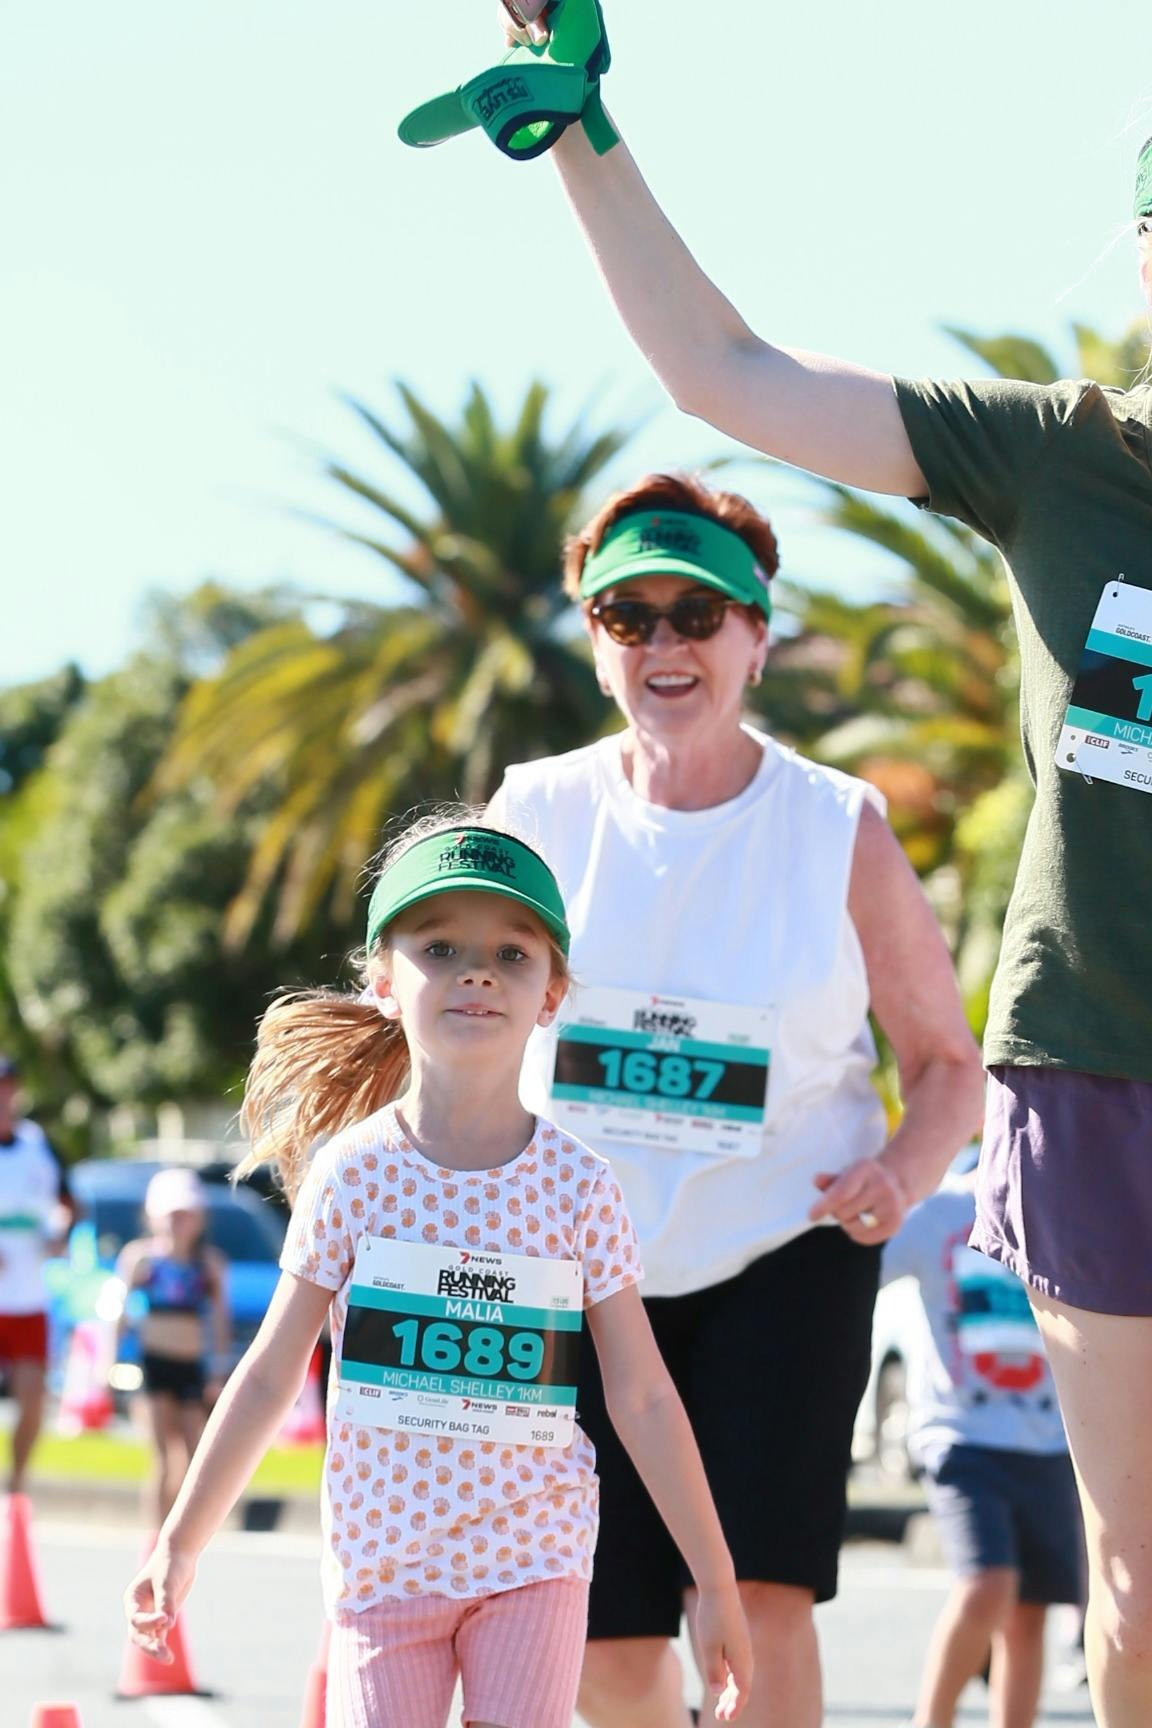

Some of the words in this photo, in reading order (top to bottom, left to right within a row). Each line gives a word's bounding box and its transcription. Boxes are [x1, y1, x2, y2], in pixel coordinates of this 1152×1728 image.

[598, 1049, 726, 1100] 1687
[438, 1269, 516, 1291] RUNNING
[448, 1265, 474, 1273] GOLD
[479, 1268, 509, 1276] COAST
[437, 1283, 514, 1303] FESTIVAL
[445, 1300, 504, 1323] MALIA
[391, 1319, 545, 1380] 1689
[382, 1370, 446, 1392] MICHAEL
[449, 1379, 515, 1400] SHELLEY
[516, 1389, 543, 1401] 1KM
[398, 1415, 447, 1431] SECURITY
[449, 1421, 469, 1432] BAG
[472, 1425, 490, 1435] TAG
[530, 1430, 555, 1441] 1689
